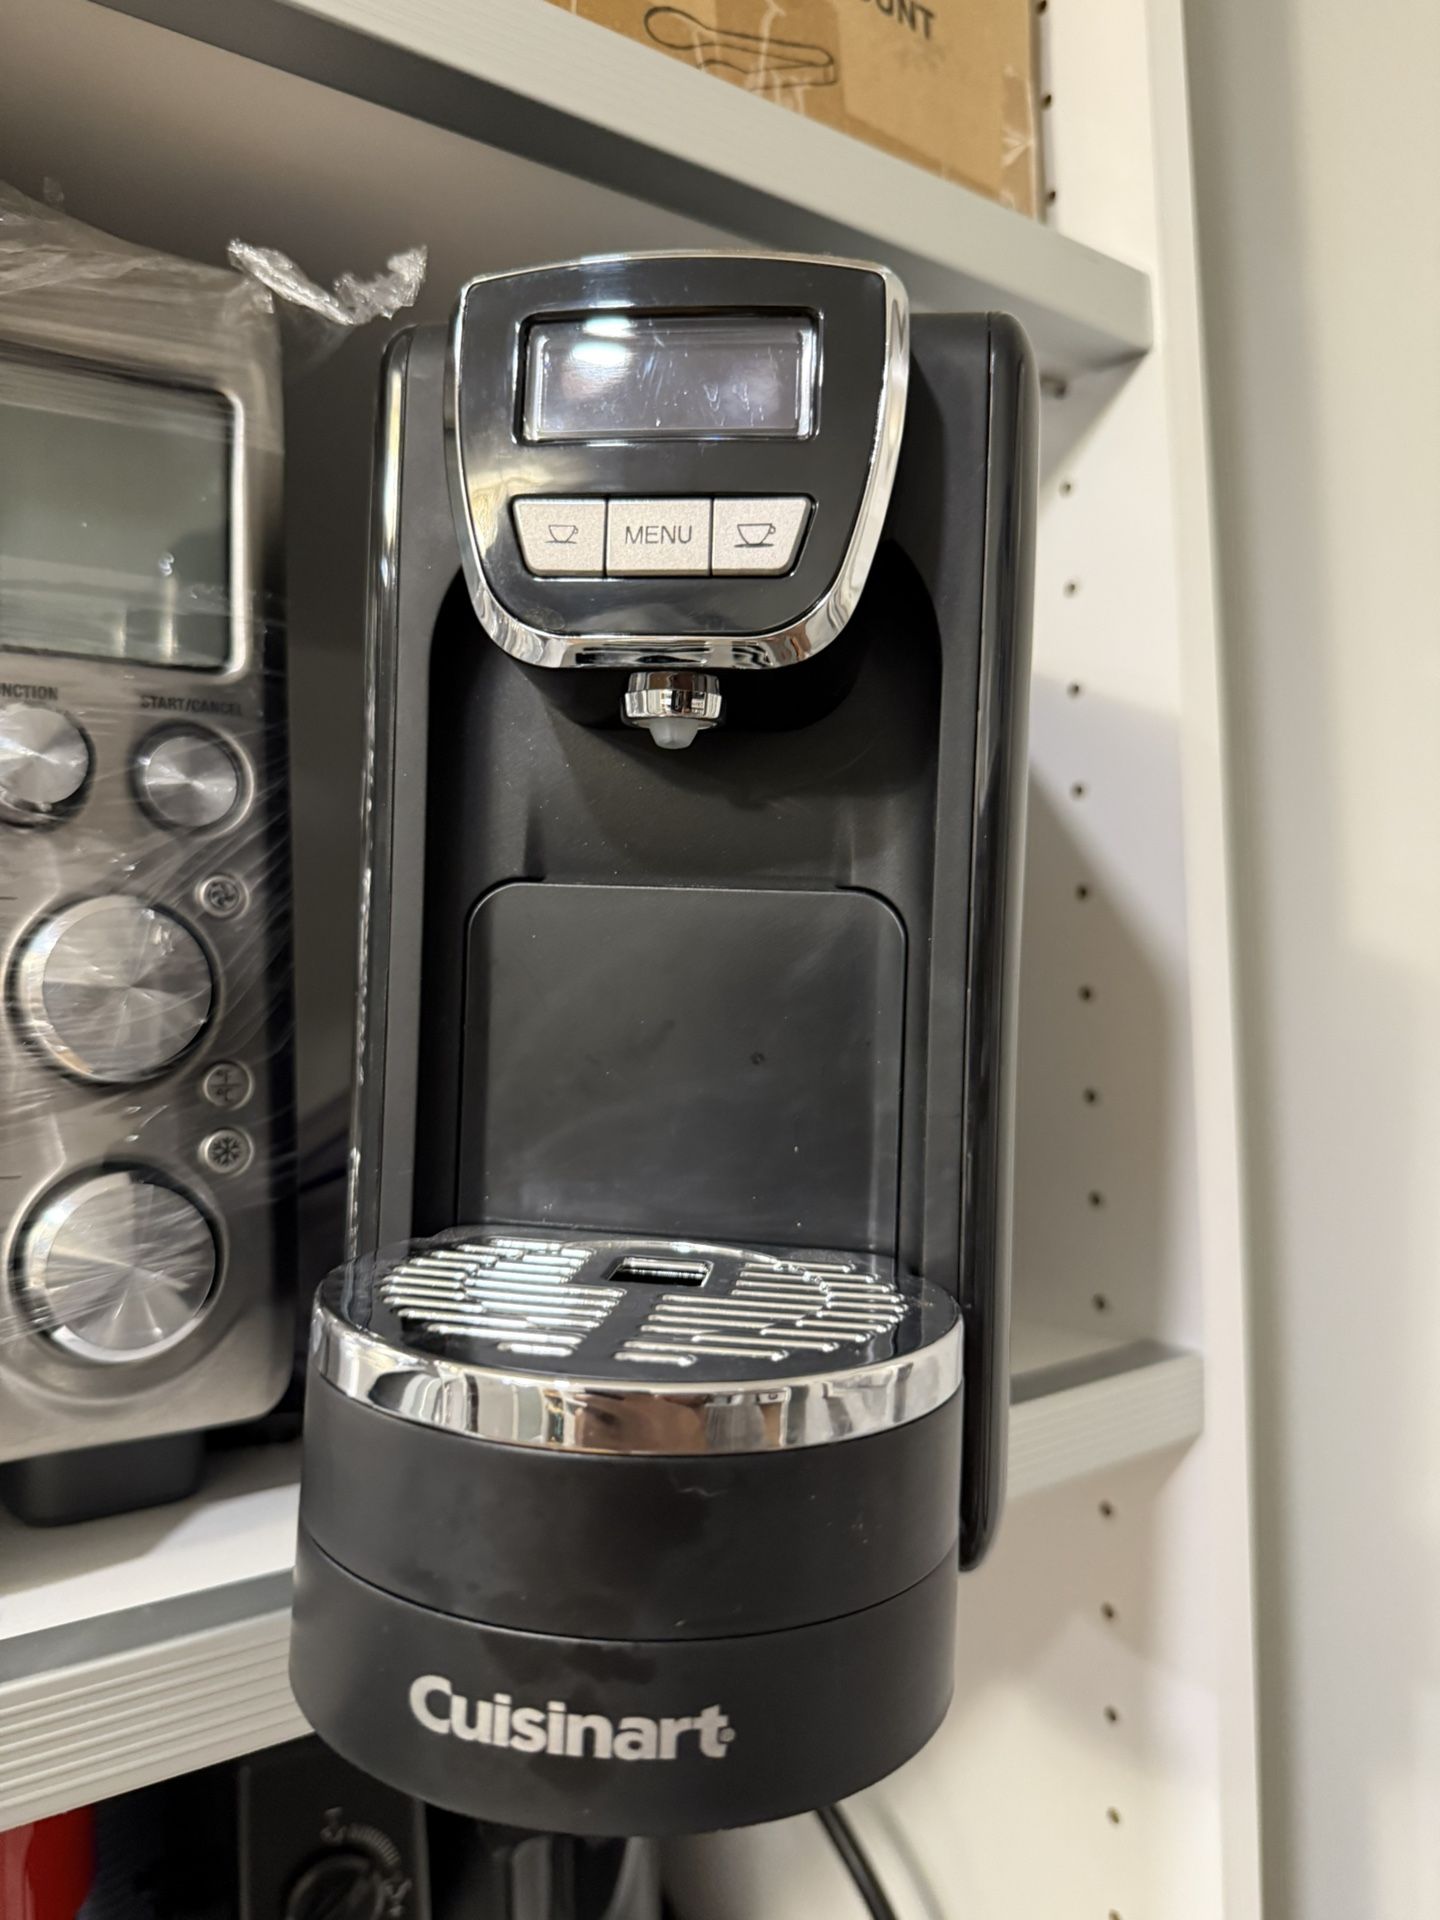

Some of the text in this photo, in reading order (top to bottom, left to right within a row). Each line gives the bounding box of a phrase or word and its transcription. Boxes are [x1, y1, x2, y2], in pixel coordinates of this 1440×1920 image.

[862, 0, 935, 40] UNT
[625, 525, 692, 544] MENU
[0, 682, 58, 701] NCTION
[141, 695, 242, 717] START/CANCEL
[409, 1674, 729, 1760] Cuisinart
